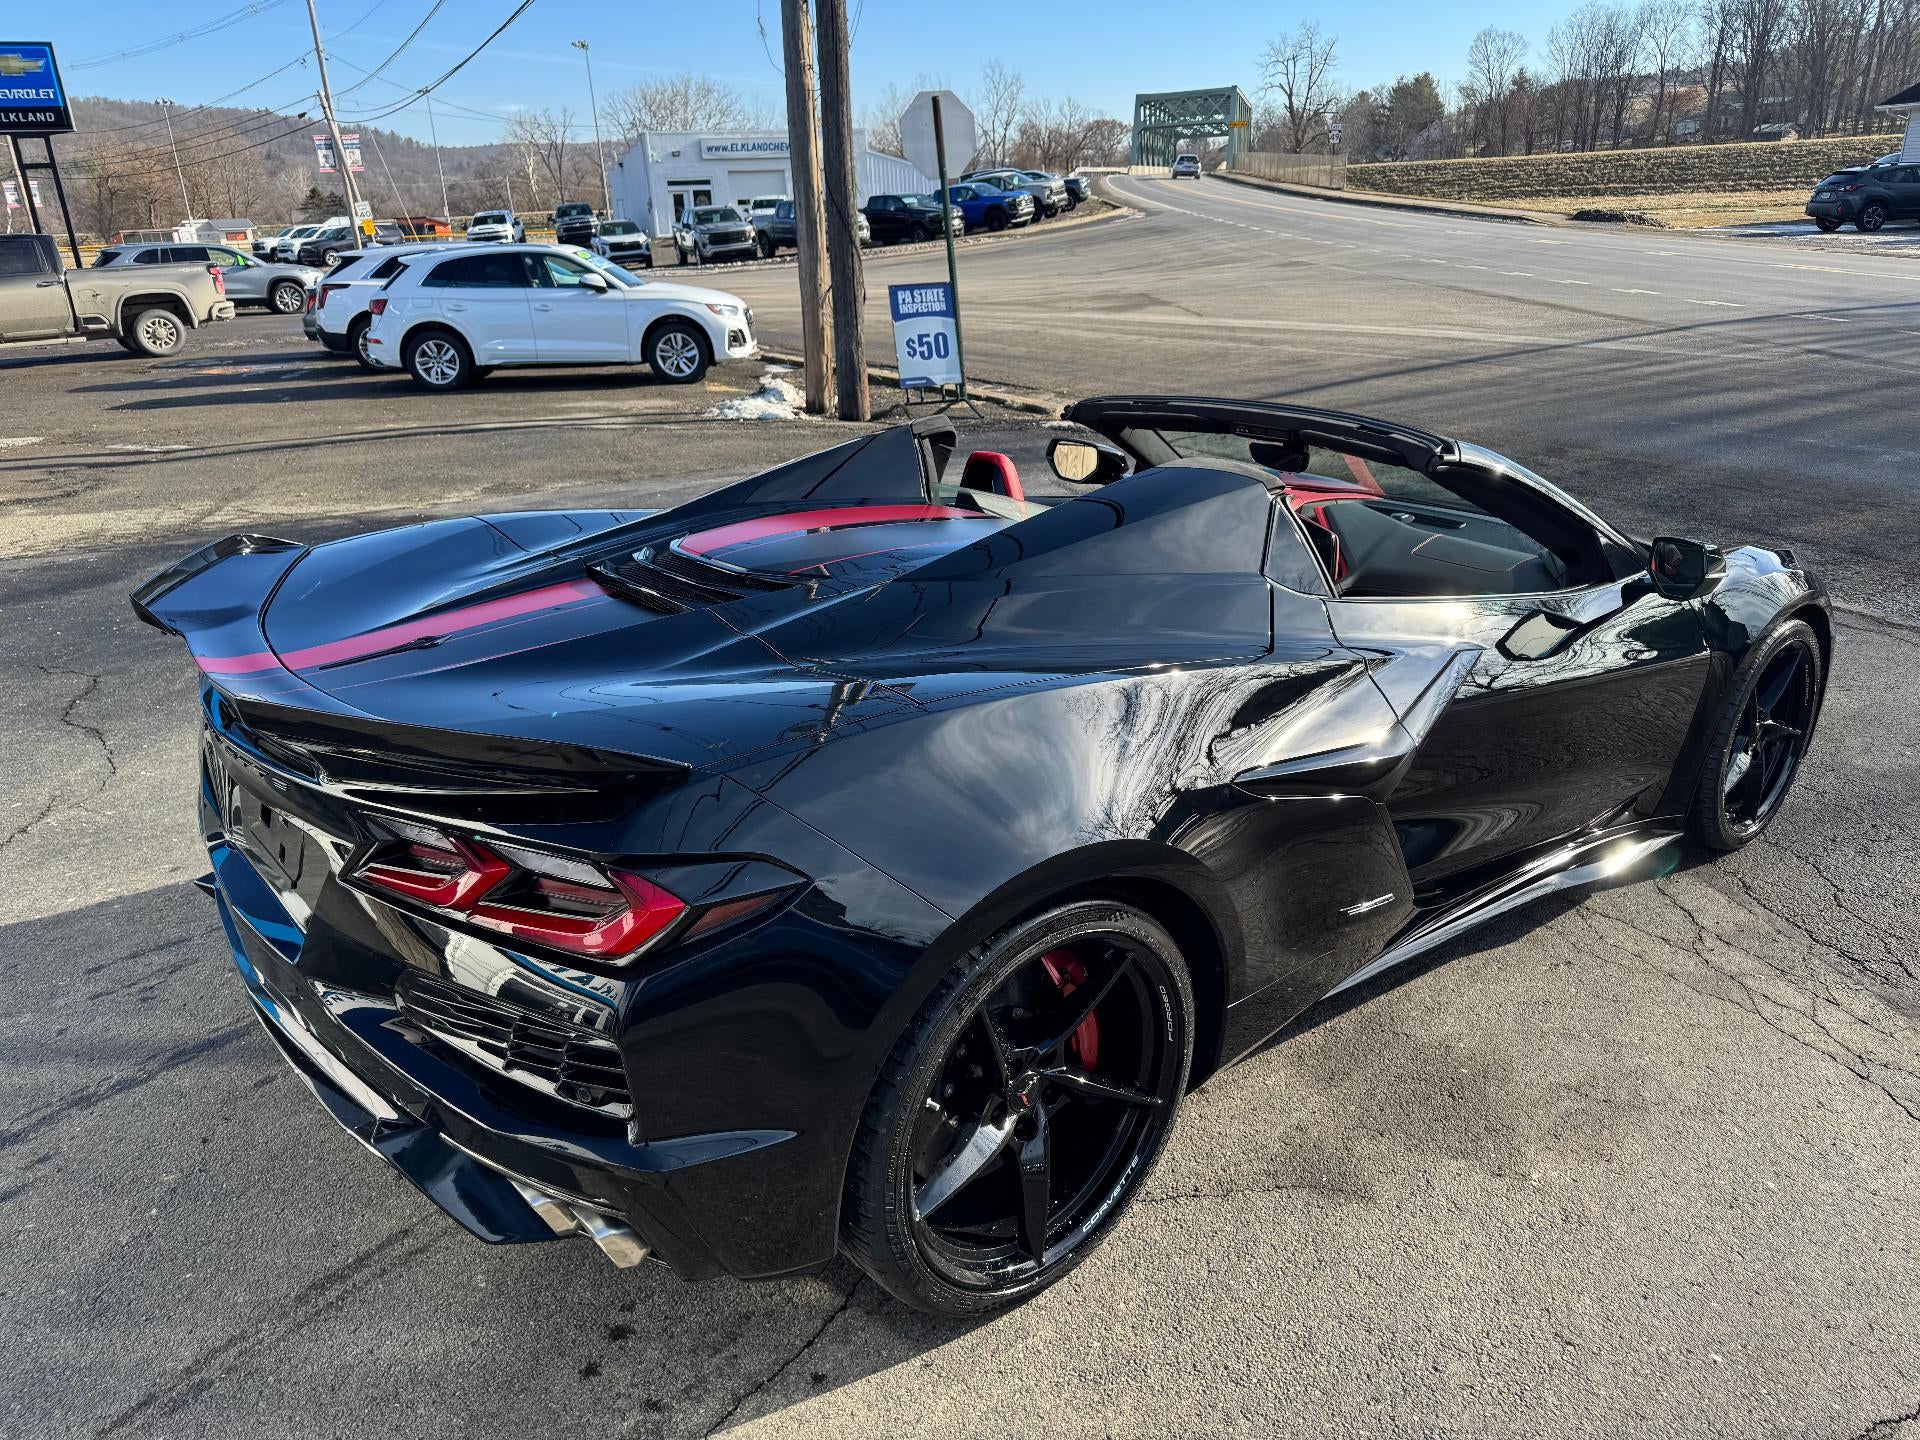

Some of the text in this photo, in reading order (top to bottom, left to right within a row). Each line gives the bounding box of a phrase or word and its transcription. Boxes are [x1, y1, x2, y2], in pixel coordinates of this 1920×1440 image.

[0, 88, 55, 99] EVROLET
[0, 112, 55, 122] LKLAND
[706, 142, 790, 152] www.ELKLANDCHEV
[360, 210, 372, 218] 40
[897, 288, 945, 304] PA STATE
[899, 301, 947, 314] INSPECTION
[905, 331, 950, 361] $50
[1160, 985, 1174, 1042] FORGED
[1083, 1154, 1139, 1232] CORVETTE
